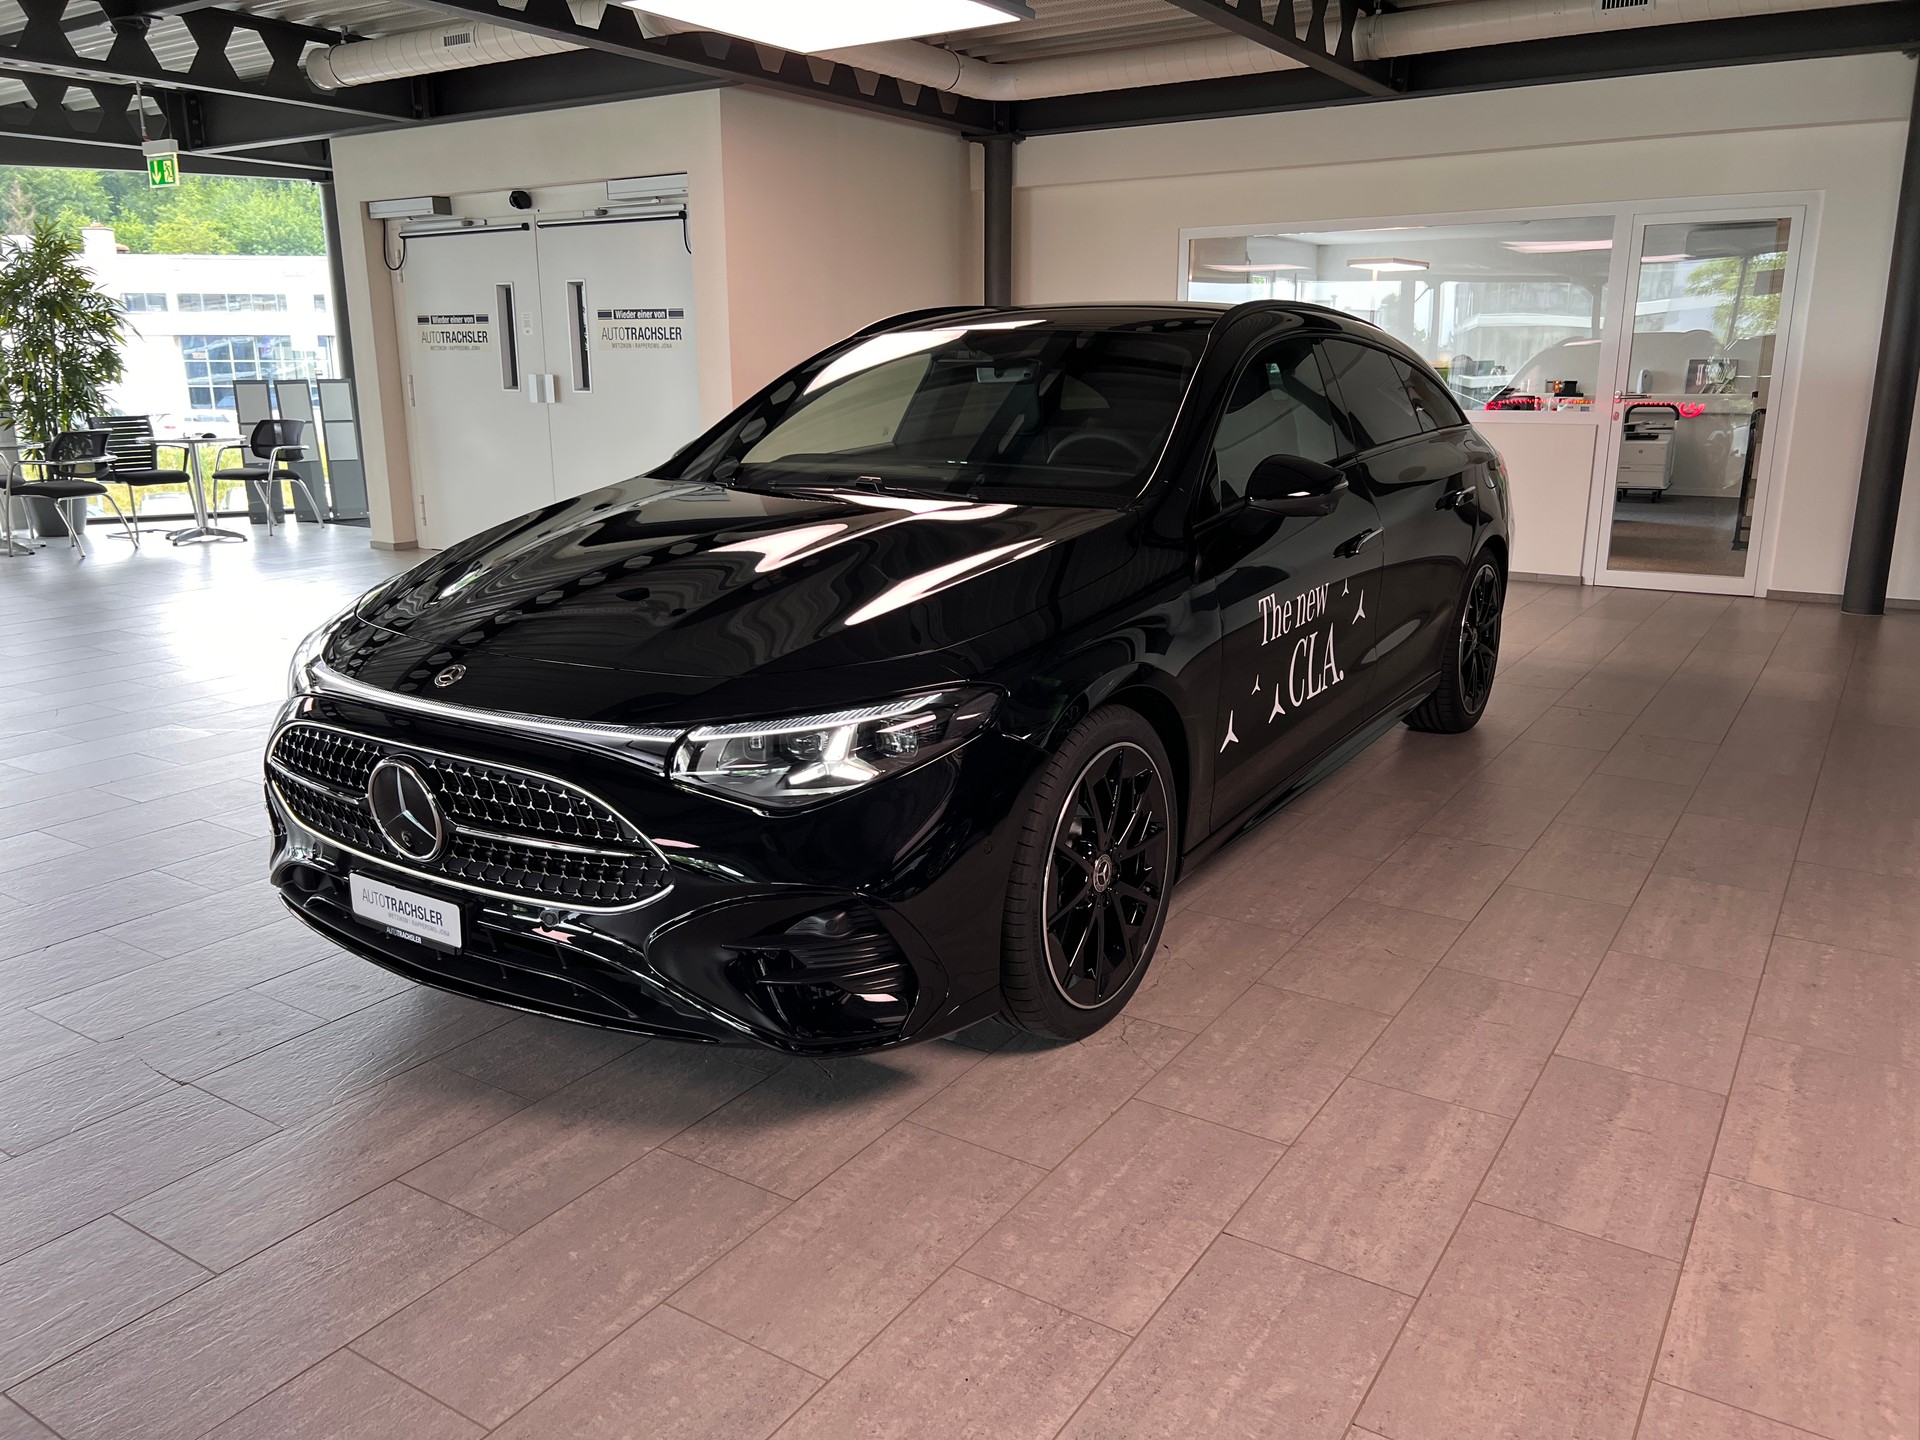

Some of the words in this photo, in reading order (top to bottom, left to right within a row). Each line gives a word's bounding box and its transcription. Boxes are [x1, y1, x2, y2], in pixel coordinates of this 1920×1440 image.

[431, 315, 449, 324] Wieder
[450, 315, 463, 323] einer
[615, 310, 636, 319] Wieder
[637, 309, 653, 319] einer
[654, 310, 665, 318] von
[421, 330, 488, 343] AUTOTRACHSLER
[601, 326, 682, 340] AUTOTRACHSLER
[1258, 592, 1292, 646] The
[1295, 582, 1330, 628] new
[1288, 622, 1345, 707] CLA.
[362, 888, 443, 927] AUTOTRACHSLER
